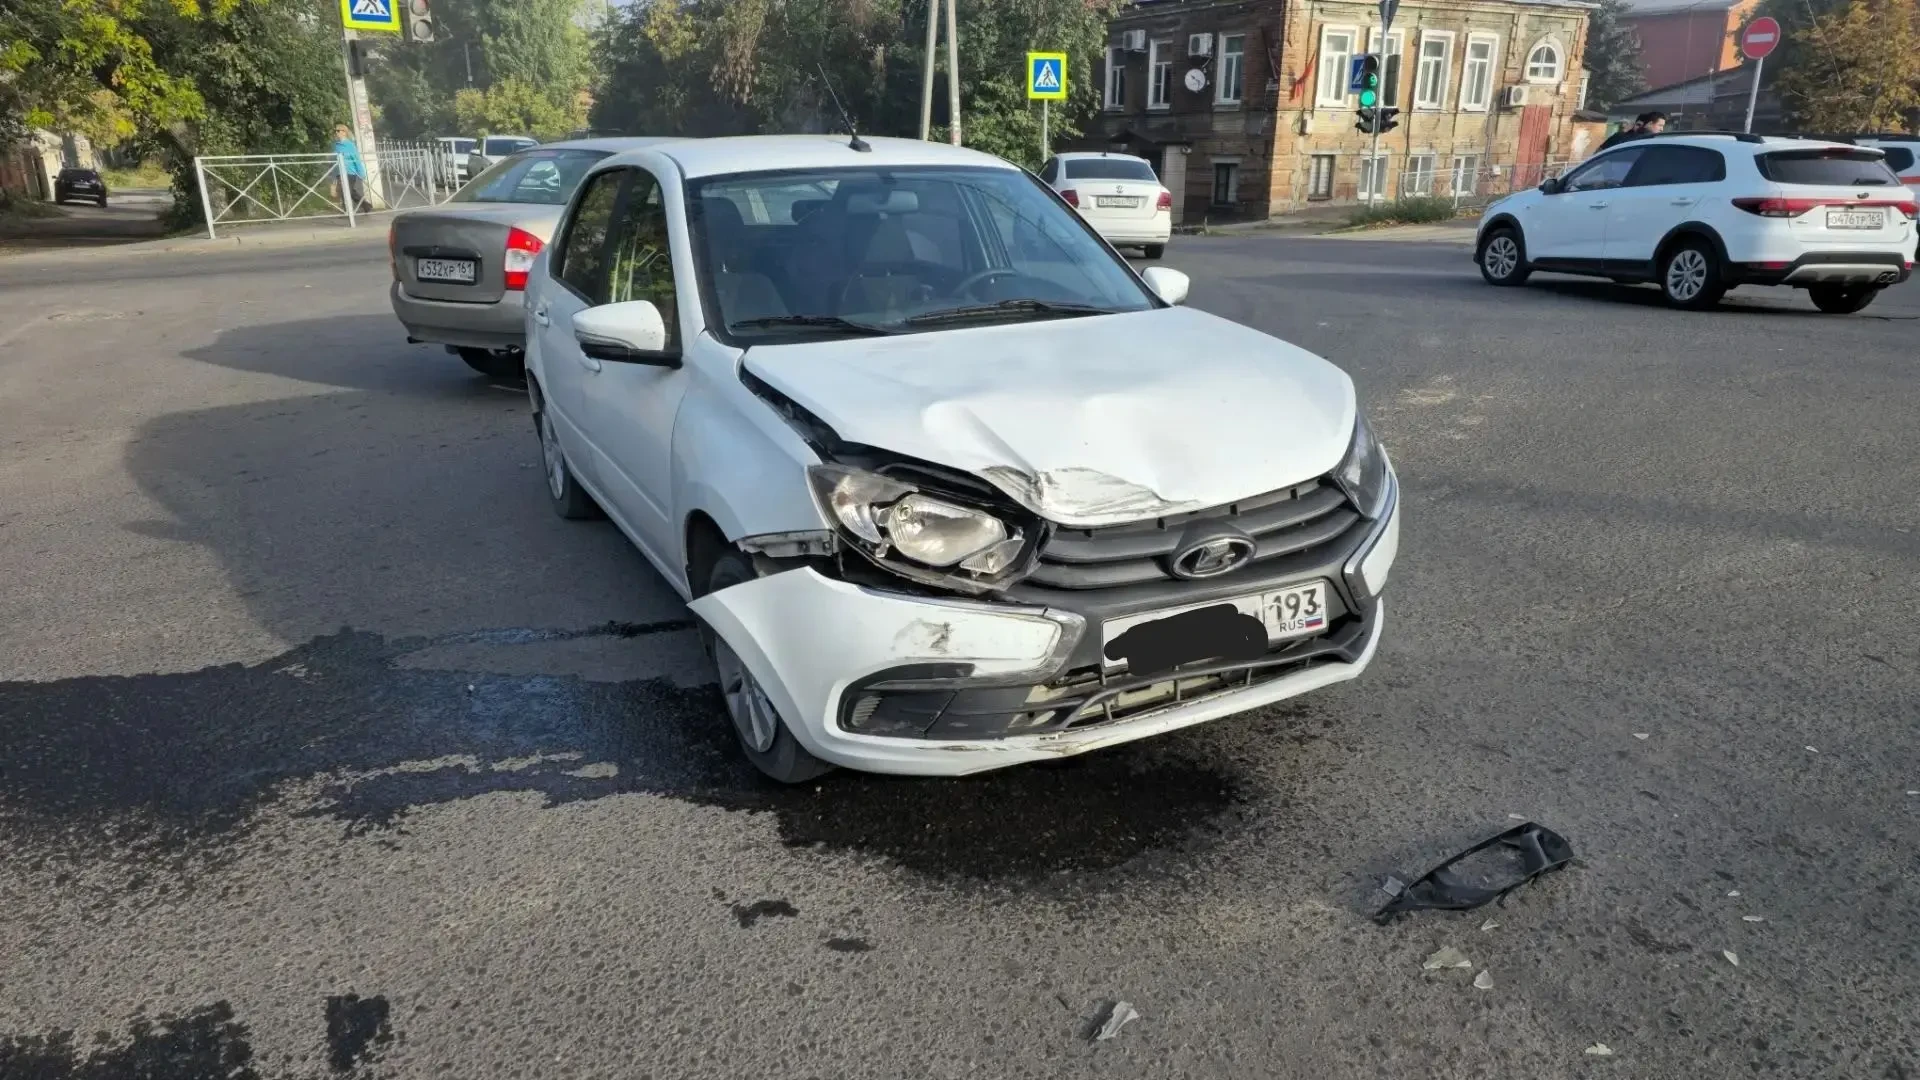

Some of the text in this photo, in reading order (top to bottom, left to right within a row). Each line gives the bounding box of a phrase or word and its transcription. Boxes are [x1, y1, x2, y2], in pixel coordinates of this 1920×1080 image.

[457, 262, 472, 274] 161
[1268, 588, 1318, 621] 193
[1279, 619, 1305, 632] RUS
